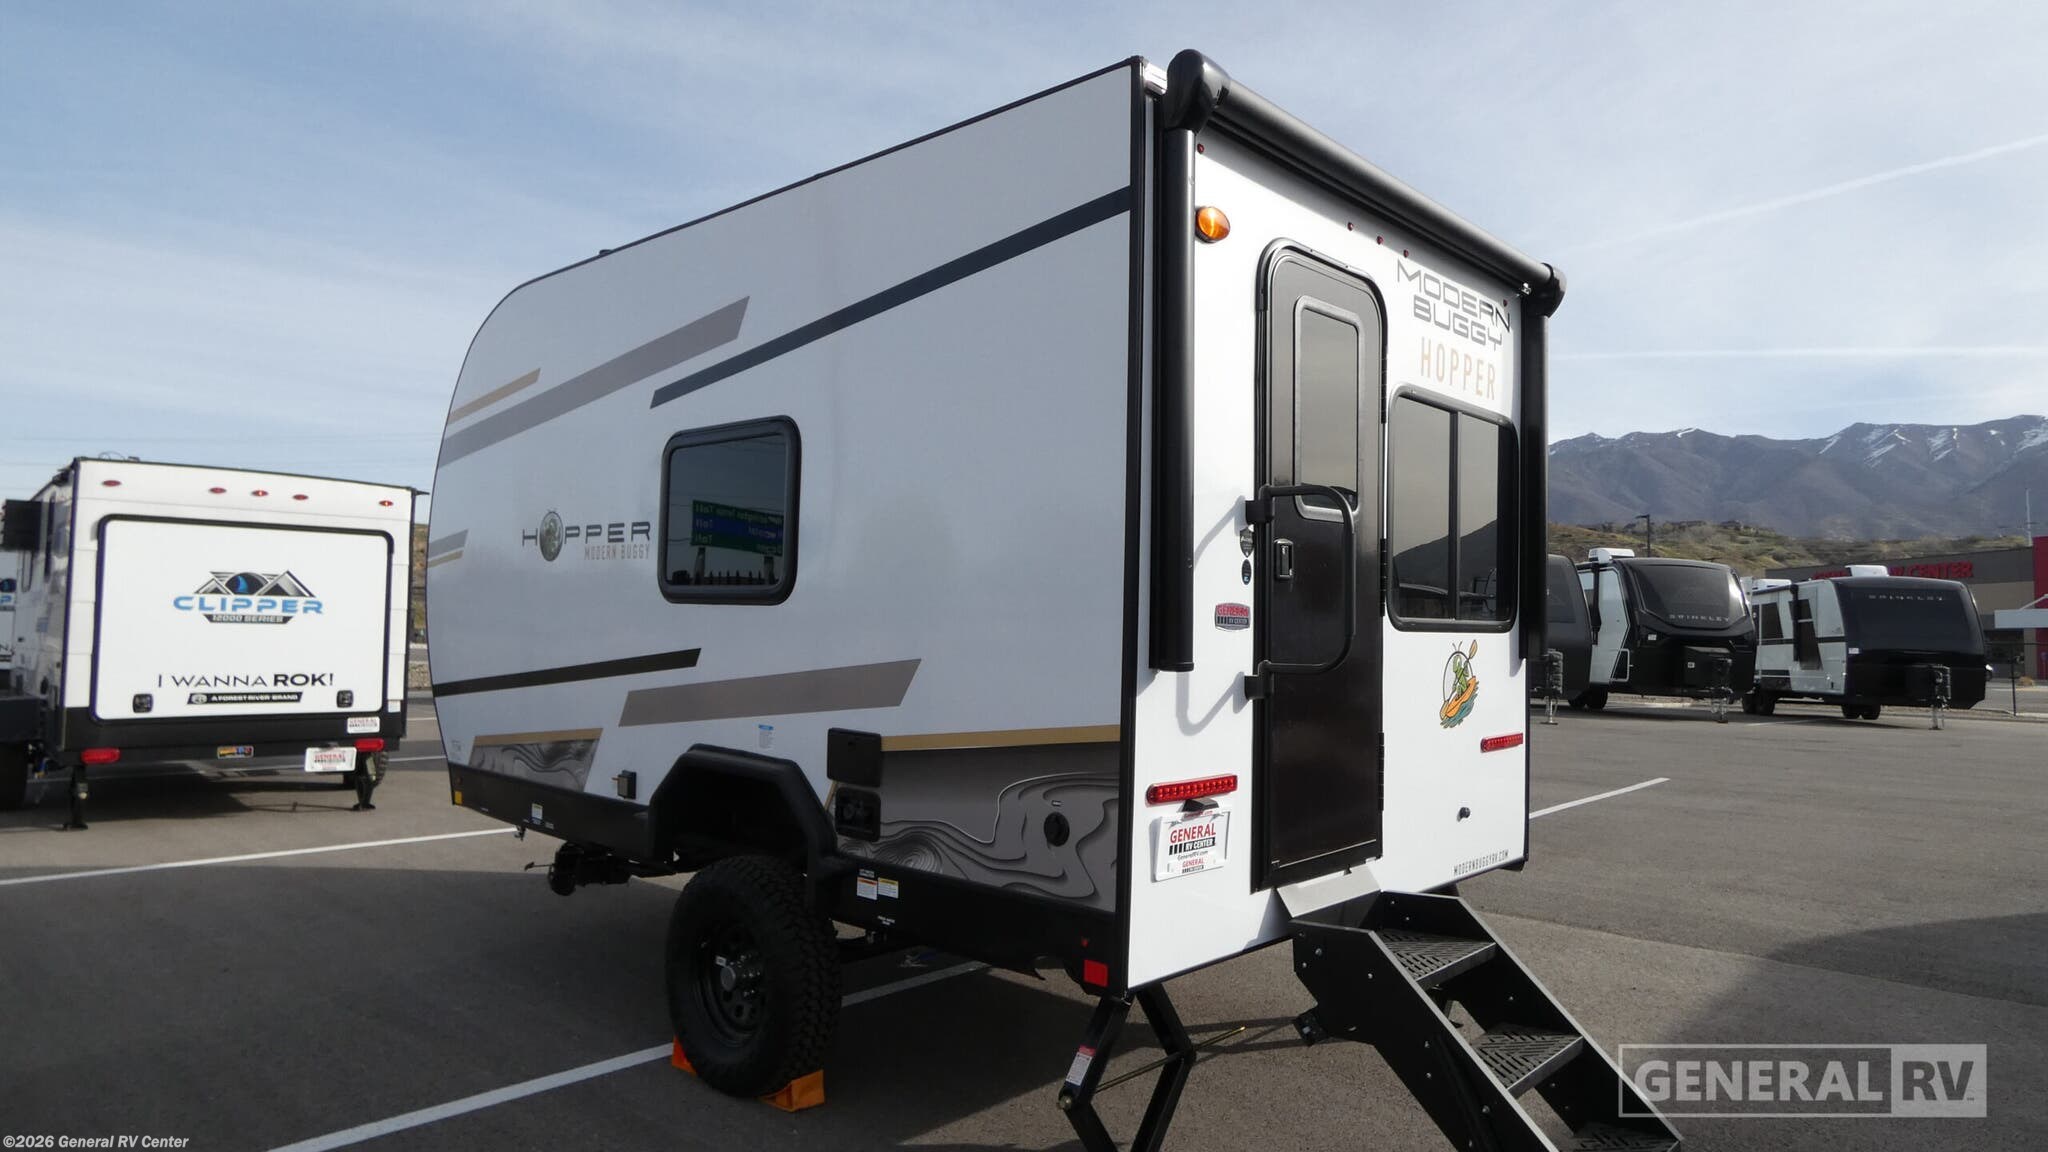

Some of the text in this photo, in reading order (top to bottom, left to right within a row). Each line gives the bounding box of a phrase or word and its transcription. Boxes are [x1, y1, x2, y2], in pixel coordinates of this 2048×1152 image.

[1397, 259, 1511, 333] MODERN
[1413, 294, 1503, 352] BUGGY
[1420, 336, 1496, 401] HOPPER
[583, 543, 650, 561] MODERN BUGGY
[173, 595, 324, 615] CLIPPER
[171, 674, 268, 688] WANNA
[273, 672, 334, 687] ROK!
[1170, 822, 1216, 844] GENERAL
[1184, 838, 1213, 852] RV CENTER
